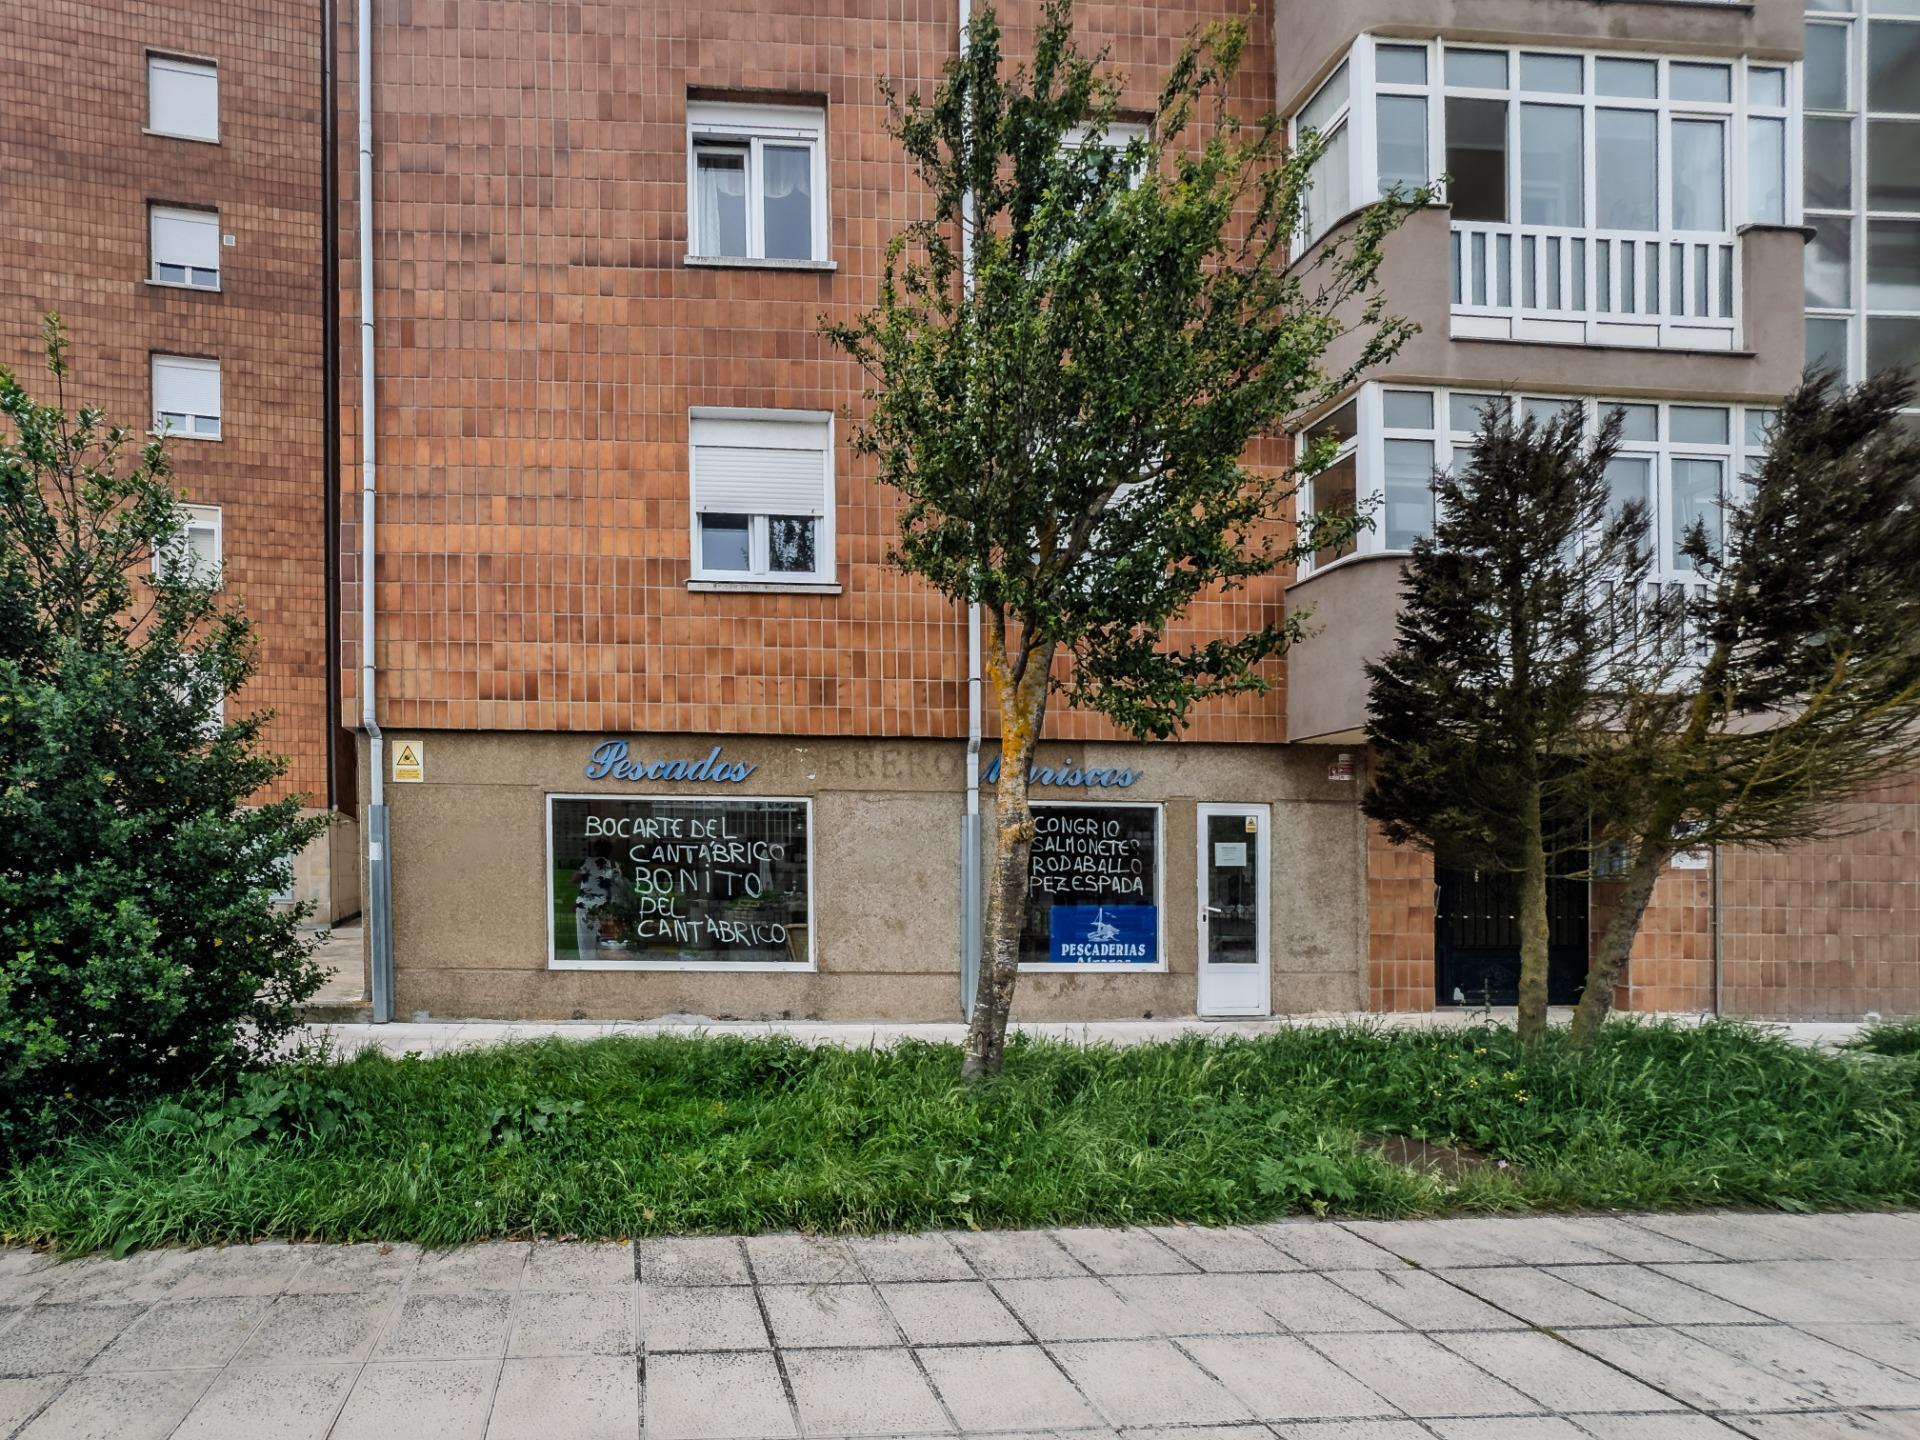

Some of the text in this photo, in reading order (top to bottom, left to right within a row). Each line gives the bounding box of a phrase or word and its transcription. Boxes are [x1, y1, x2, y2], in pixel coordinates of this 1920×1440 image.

[584, 739, 758, 783] Pescados
[979, 753, 1144, 789] riscos
[584, 815, 738, 839] BOCARTE DEL
[1033, 816, 1120, 838] CONGRIO
[1032, 855, 1143, 875] RODABALLO
[639, 896, 686, 920] DEL
[1060, 943, 1147, 957] PESCADERIAS
